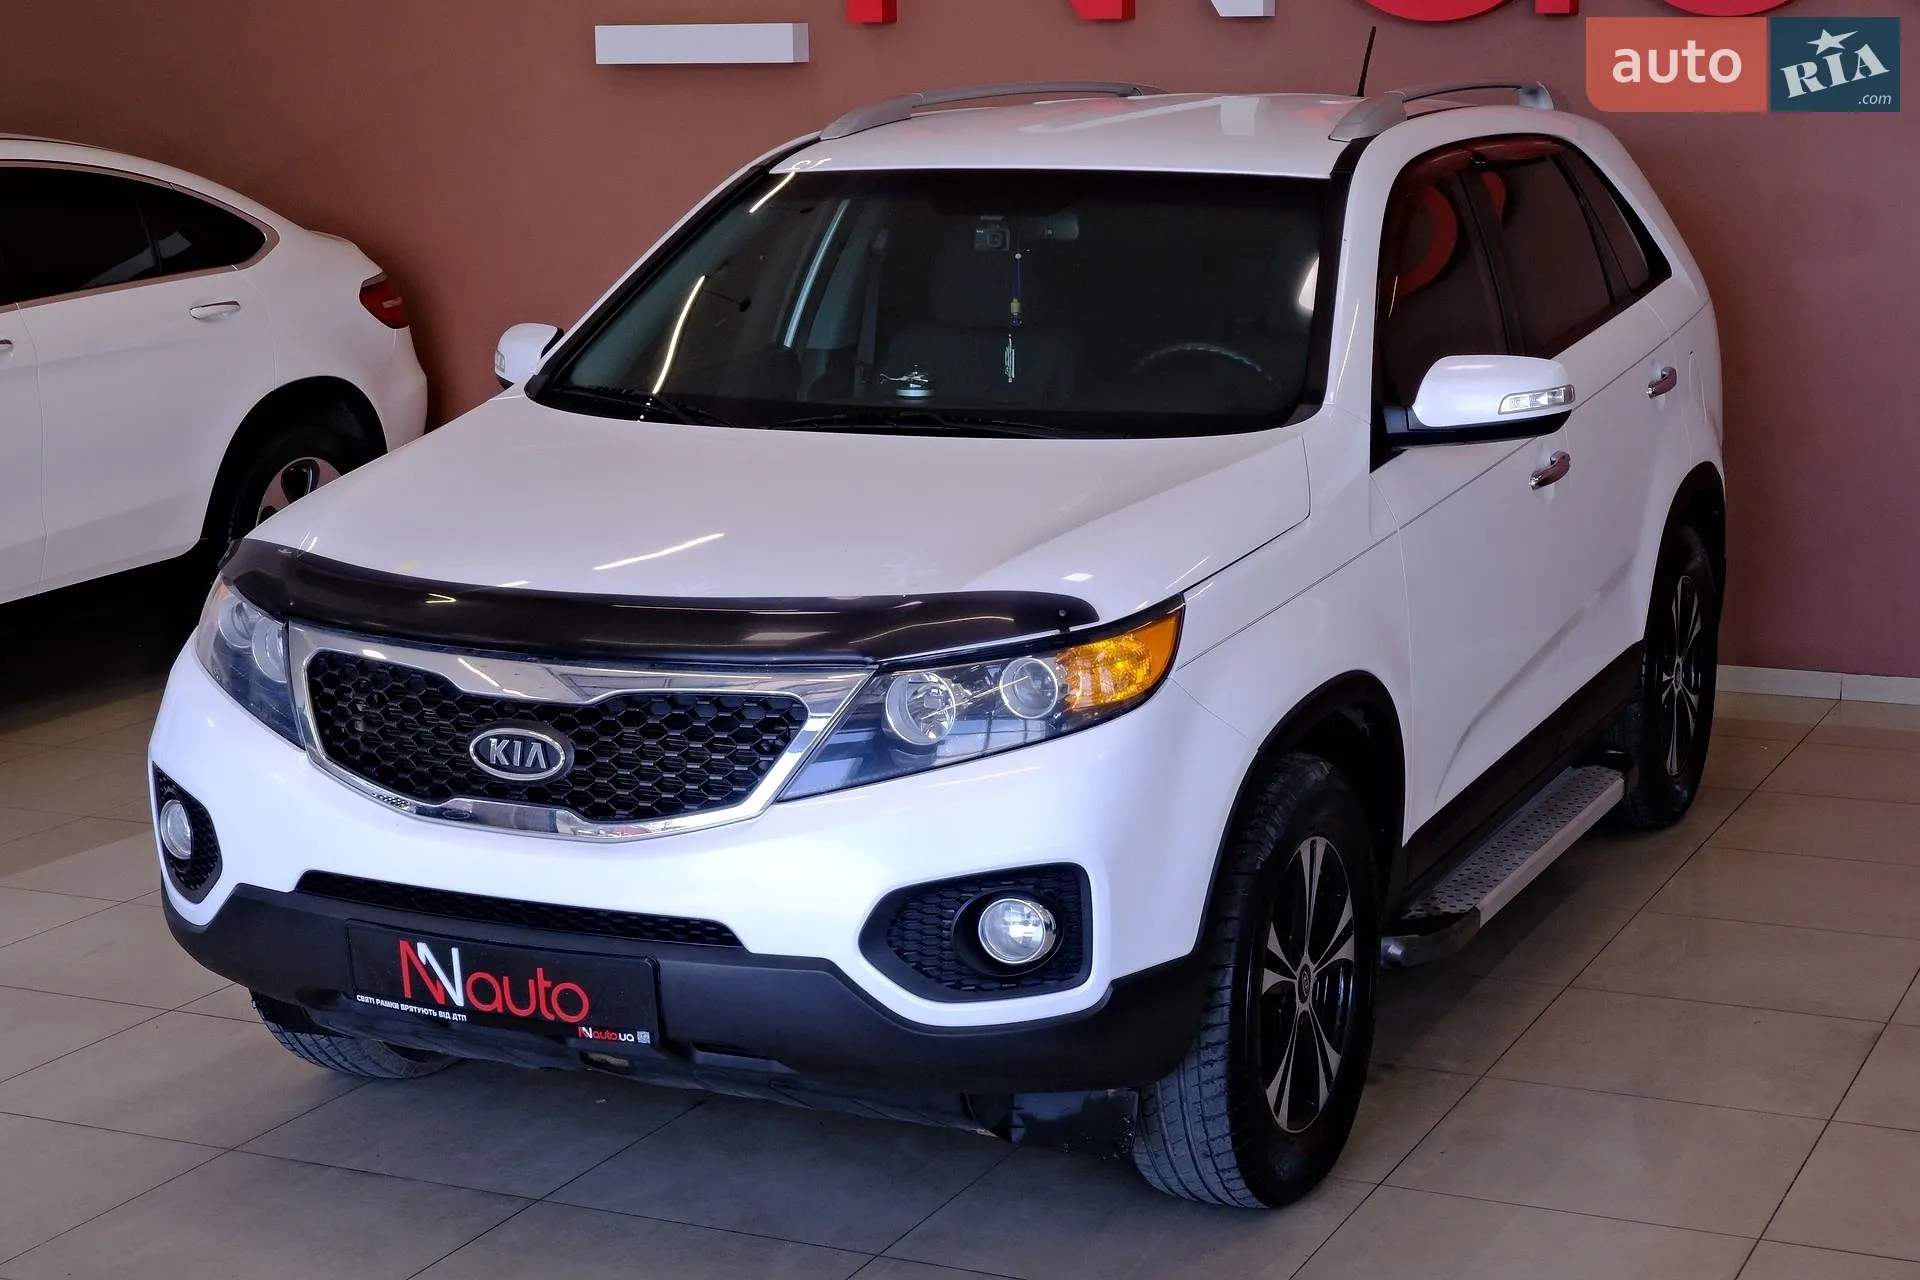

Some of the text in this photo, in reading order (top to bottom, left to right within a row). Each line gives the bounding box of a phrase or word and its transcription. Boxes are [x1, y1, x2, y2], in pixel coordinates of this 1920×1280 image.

[489, 737, 547, 769] KIA
[356, 994, 467, 1022] СВЯТІ РАМКИ ВРЯТУЮТЬ ВІД ДТП
